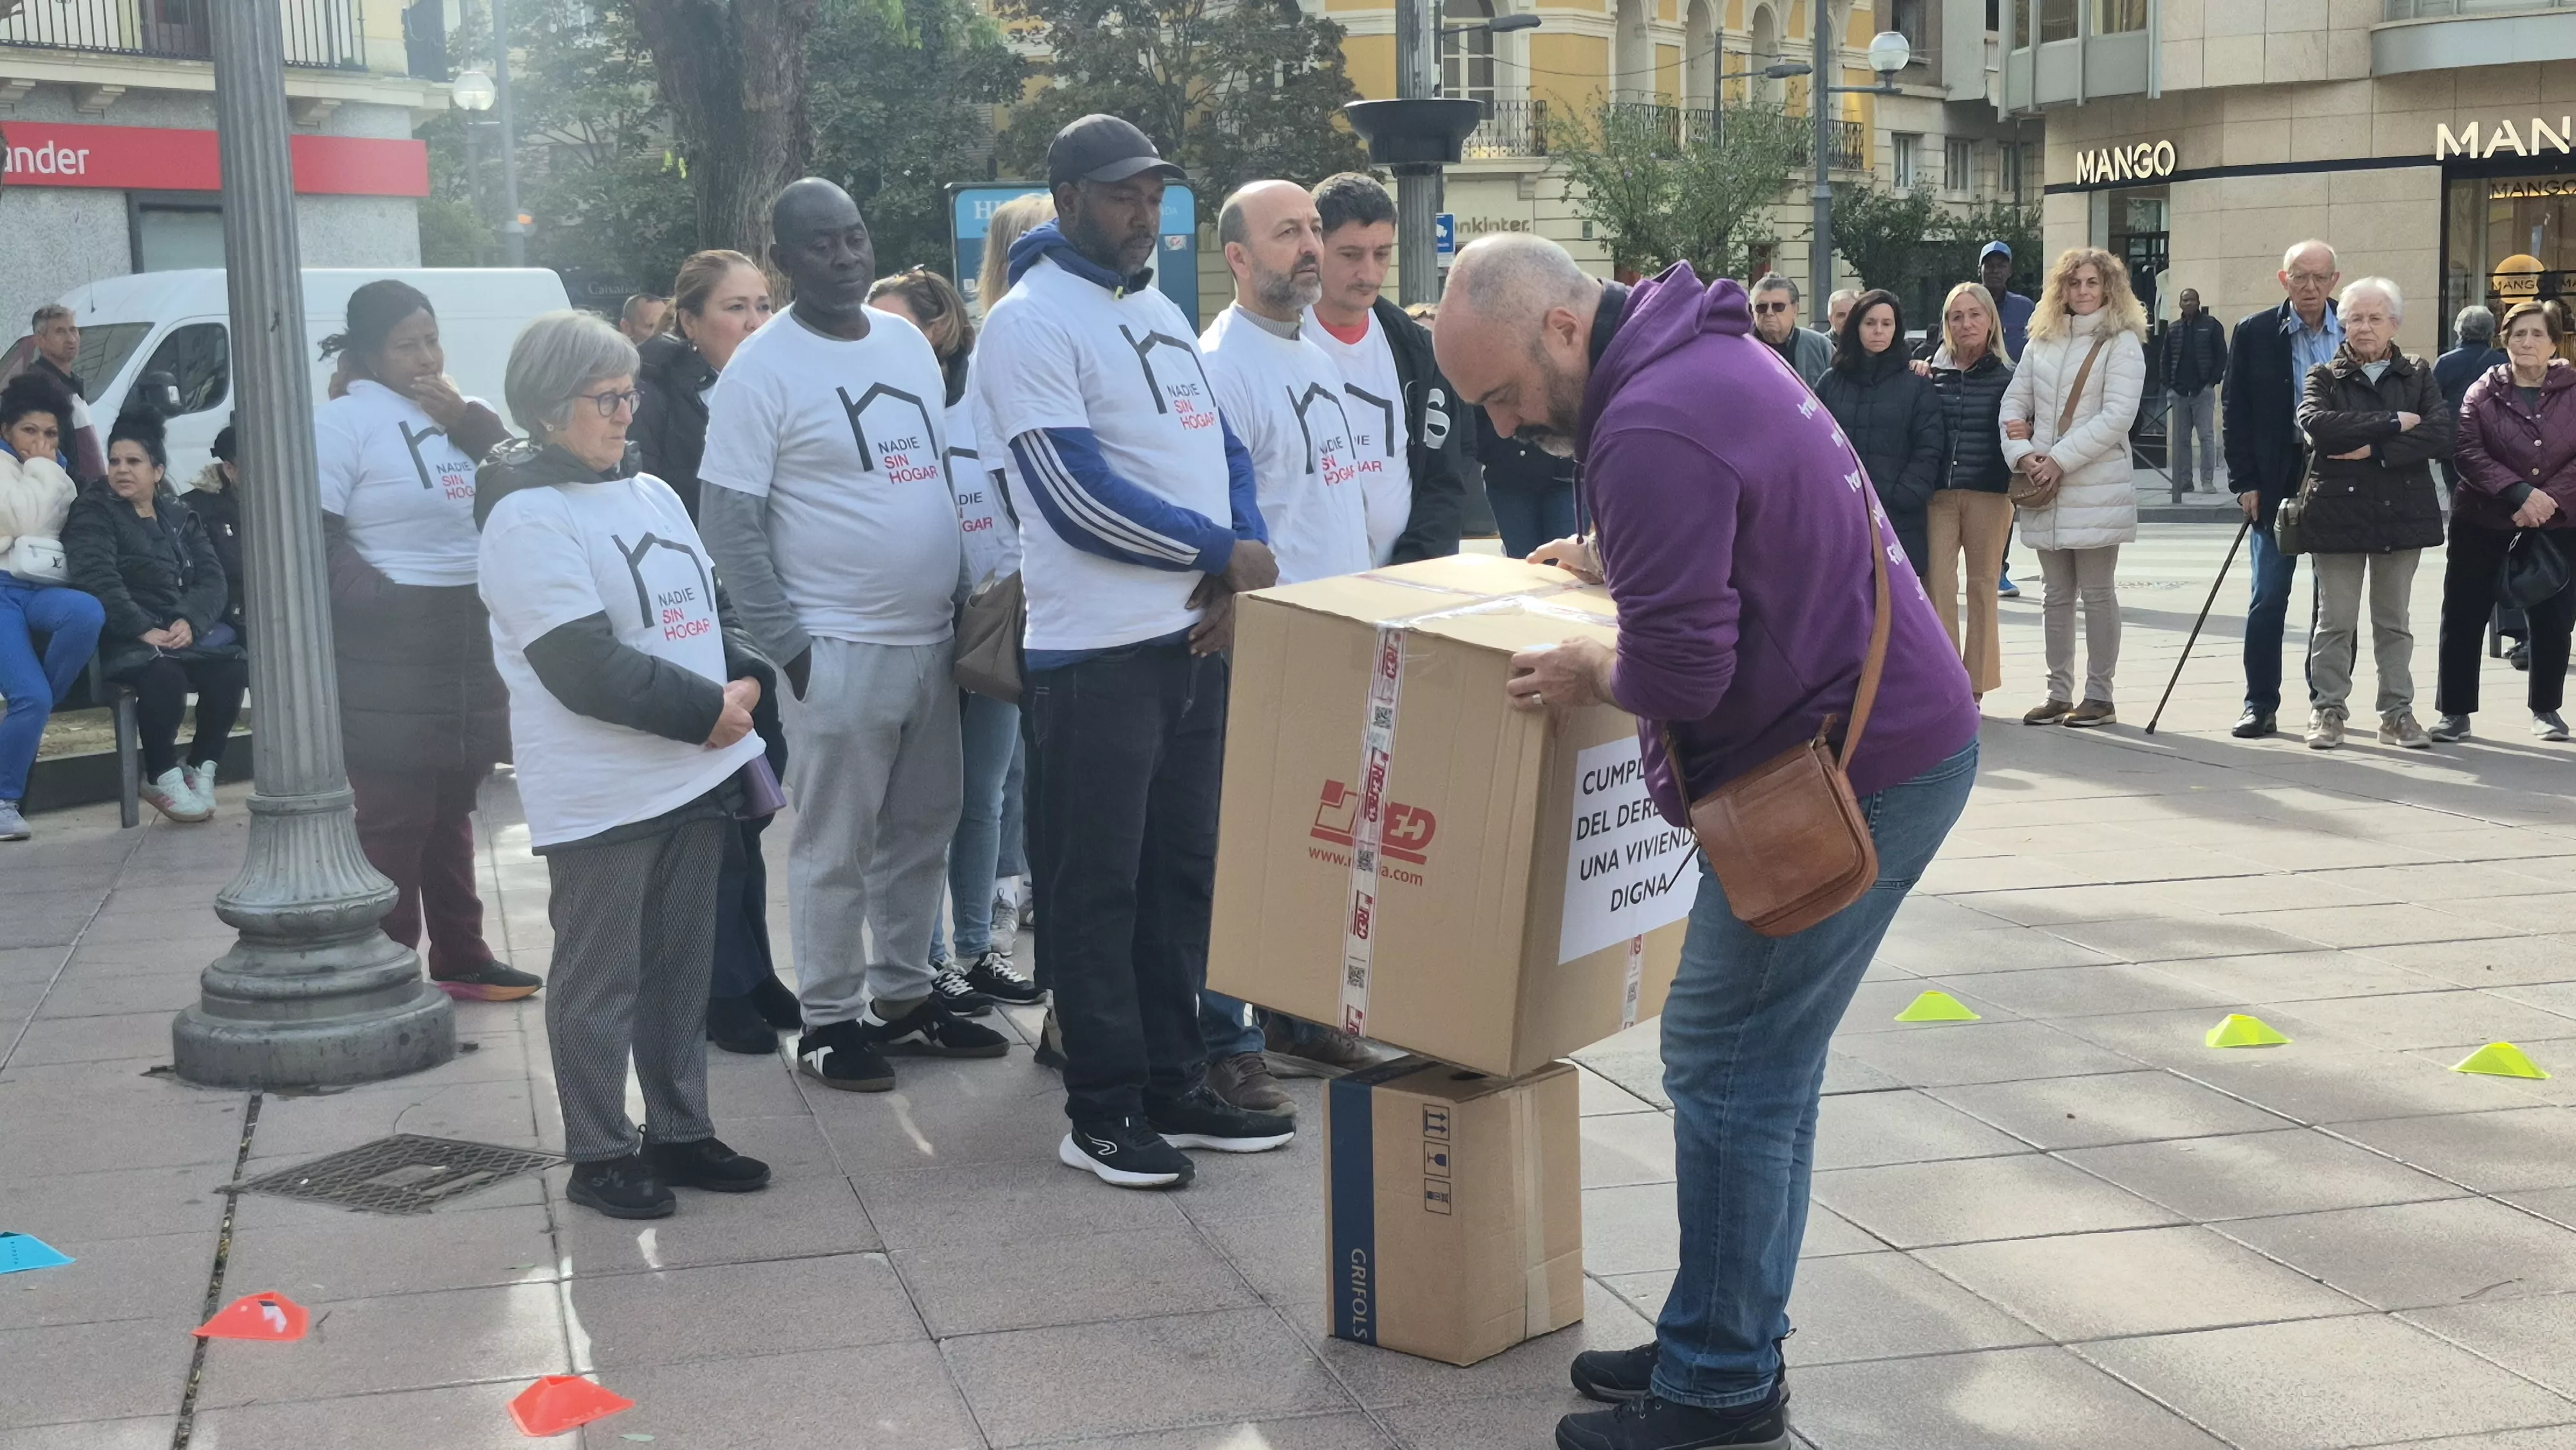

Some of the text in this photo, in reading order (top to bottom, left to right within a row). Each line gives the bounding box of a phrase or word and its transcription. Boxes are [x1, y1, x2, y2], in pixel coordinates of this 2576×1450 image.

[2436, 115, 2571, 162] MAN
[2076, 140, 2176, 186] MANGO
[1455, 216, 1531, 234] nkinter.
[2491, 279, 2539, 290] MANG
[1166, 383, 1200, 398] NADIE
[1173, 399, 1195, 414] SIN
[1179, 411, 1217, 431] HOGAR
[877, 436, 921, 455] NADIE
[435, 461, 473, 475] NADIE
[884, 453, 910, 470] SIN
[441, 475, 464, 487] SIN
[888, 465, 939, 485] HOGAR
[658, 587, 696, 607] NADIE
[662, 607, 685, 624] SIN
[664, 617, 712, 641] HOGAR
[1576, 810, 1611, 841] DEL
[1580, 848, 1619, 881] UNA
[1350, 1247, 1368, 1341] GRIFOLS
